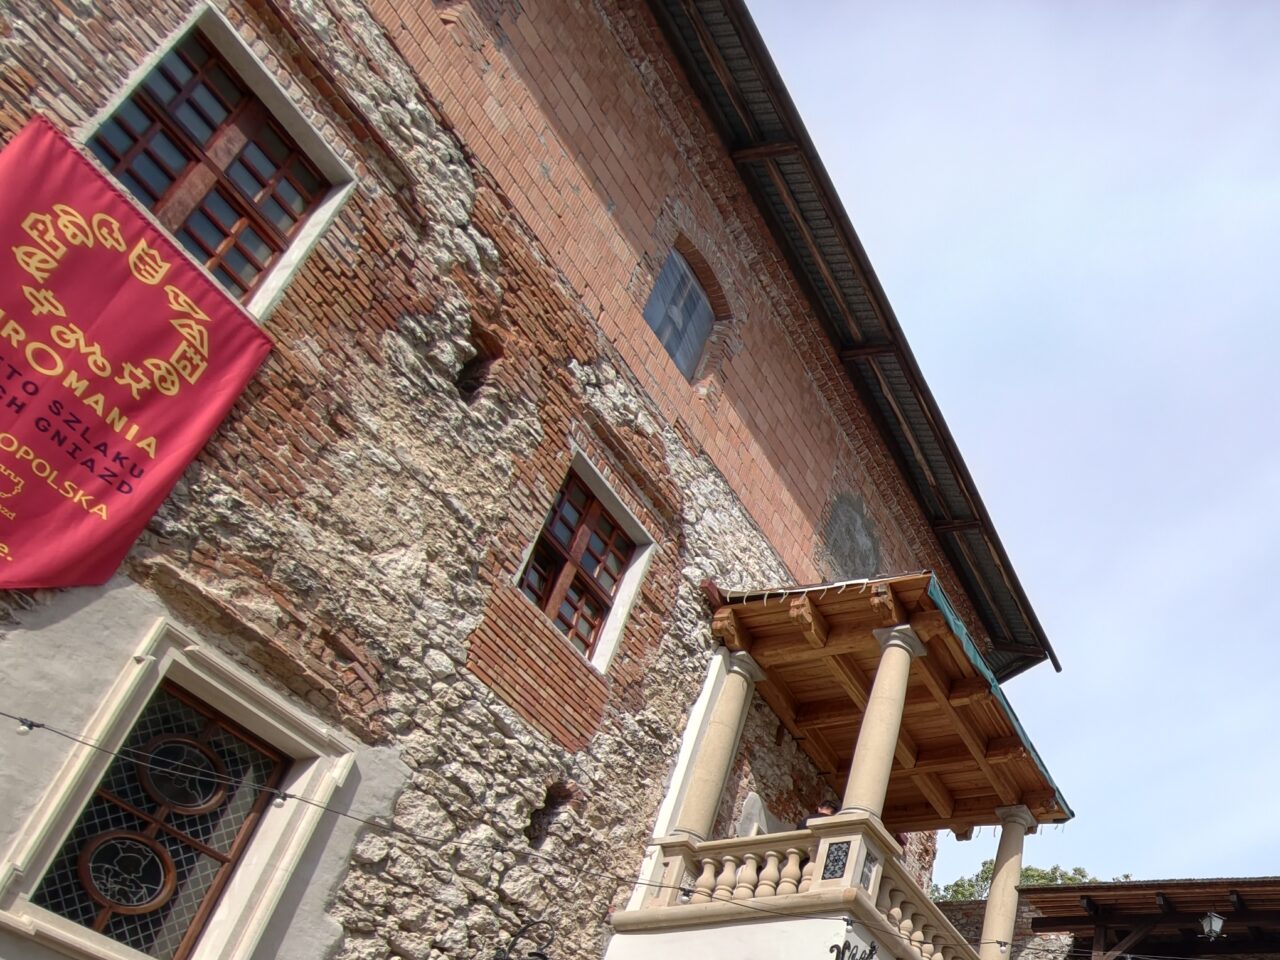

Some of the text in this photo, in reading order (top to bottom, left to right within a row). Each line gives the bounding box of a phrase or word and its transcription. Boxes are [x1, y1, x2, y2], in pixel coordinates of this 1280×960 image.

[0, 309, 157, 459] ROMANIA
[0, 356, 144, 478] TO SZLAKU
[0, 433, 108, 520] OPOLSKA
[35, 416, 133, 494] GNIAZD
